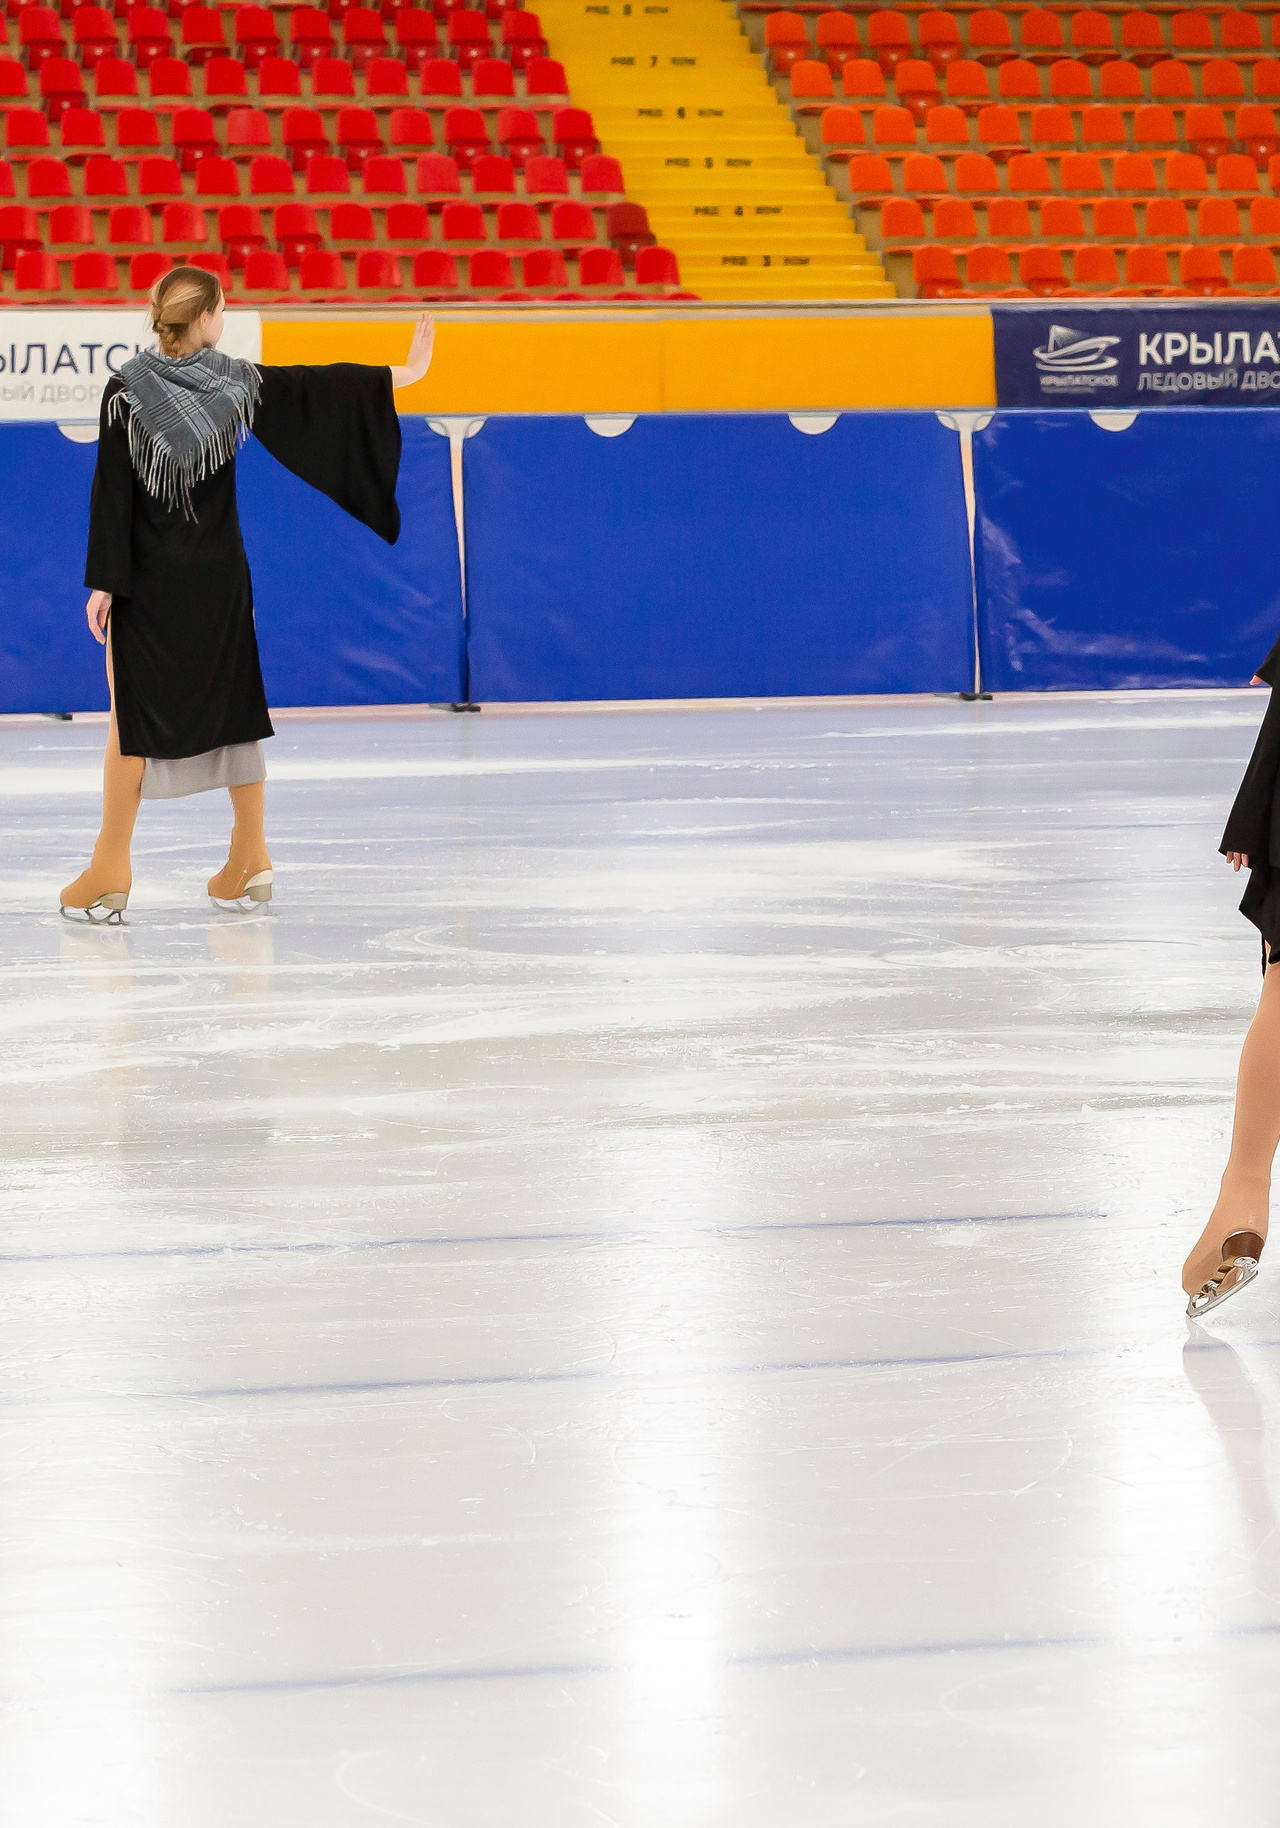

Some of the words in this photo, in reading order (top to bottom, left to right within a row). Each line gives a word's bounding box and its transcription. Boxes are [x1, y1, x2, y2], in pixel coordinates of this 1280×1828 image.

[650, 55, 658, 67] 7
[734, 205, 743, 217] 4
[0, 343, 155, 374] ЛАТС
[1138, 368, 1238, 392] ЛЕДОВЫЙ
[40, 383, 102, 403] ДВОР
